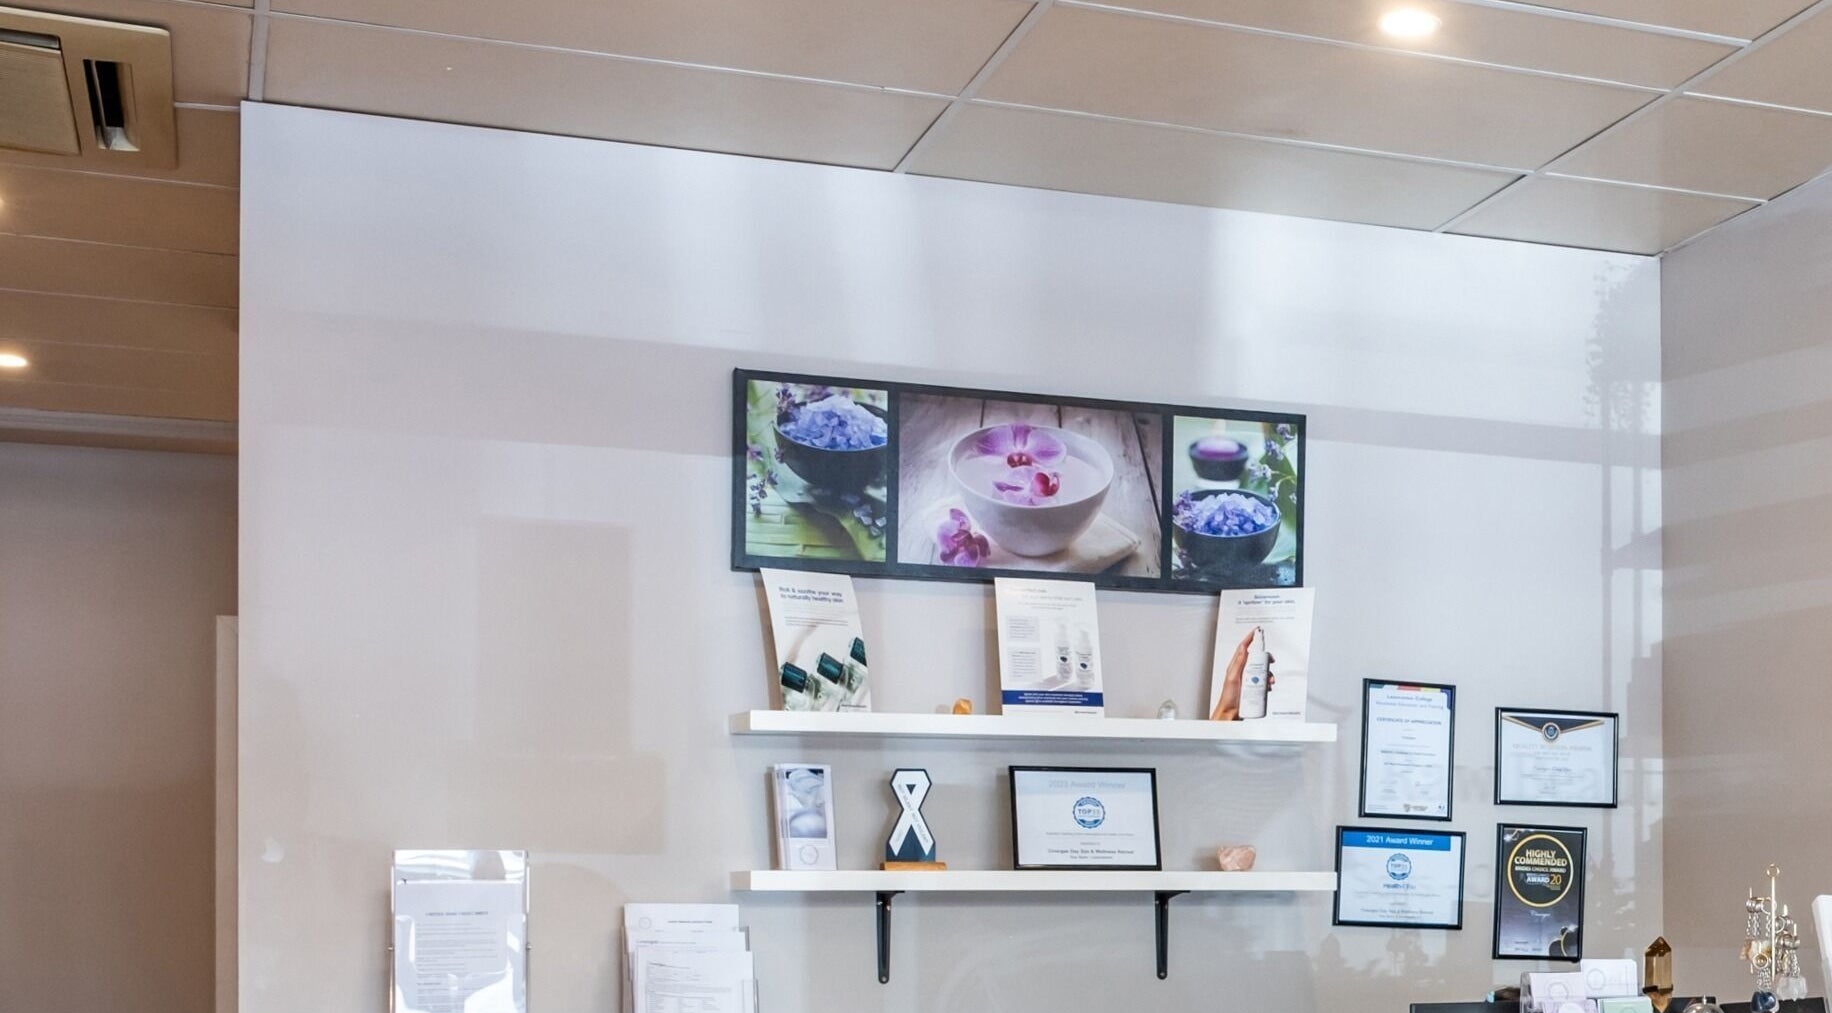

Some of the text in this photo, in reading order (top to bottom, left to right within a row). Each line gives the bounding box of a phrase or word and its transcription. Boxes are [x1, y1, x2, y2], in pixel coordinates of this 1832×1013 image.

[1366, 835, 1434, 846] 2021 Award Winner
[1525, 848, 1557, 858] HIGHLY
[1514, 856, 1568, 867] COMMENDED
